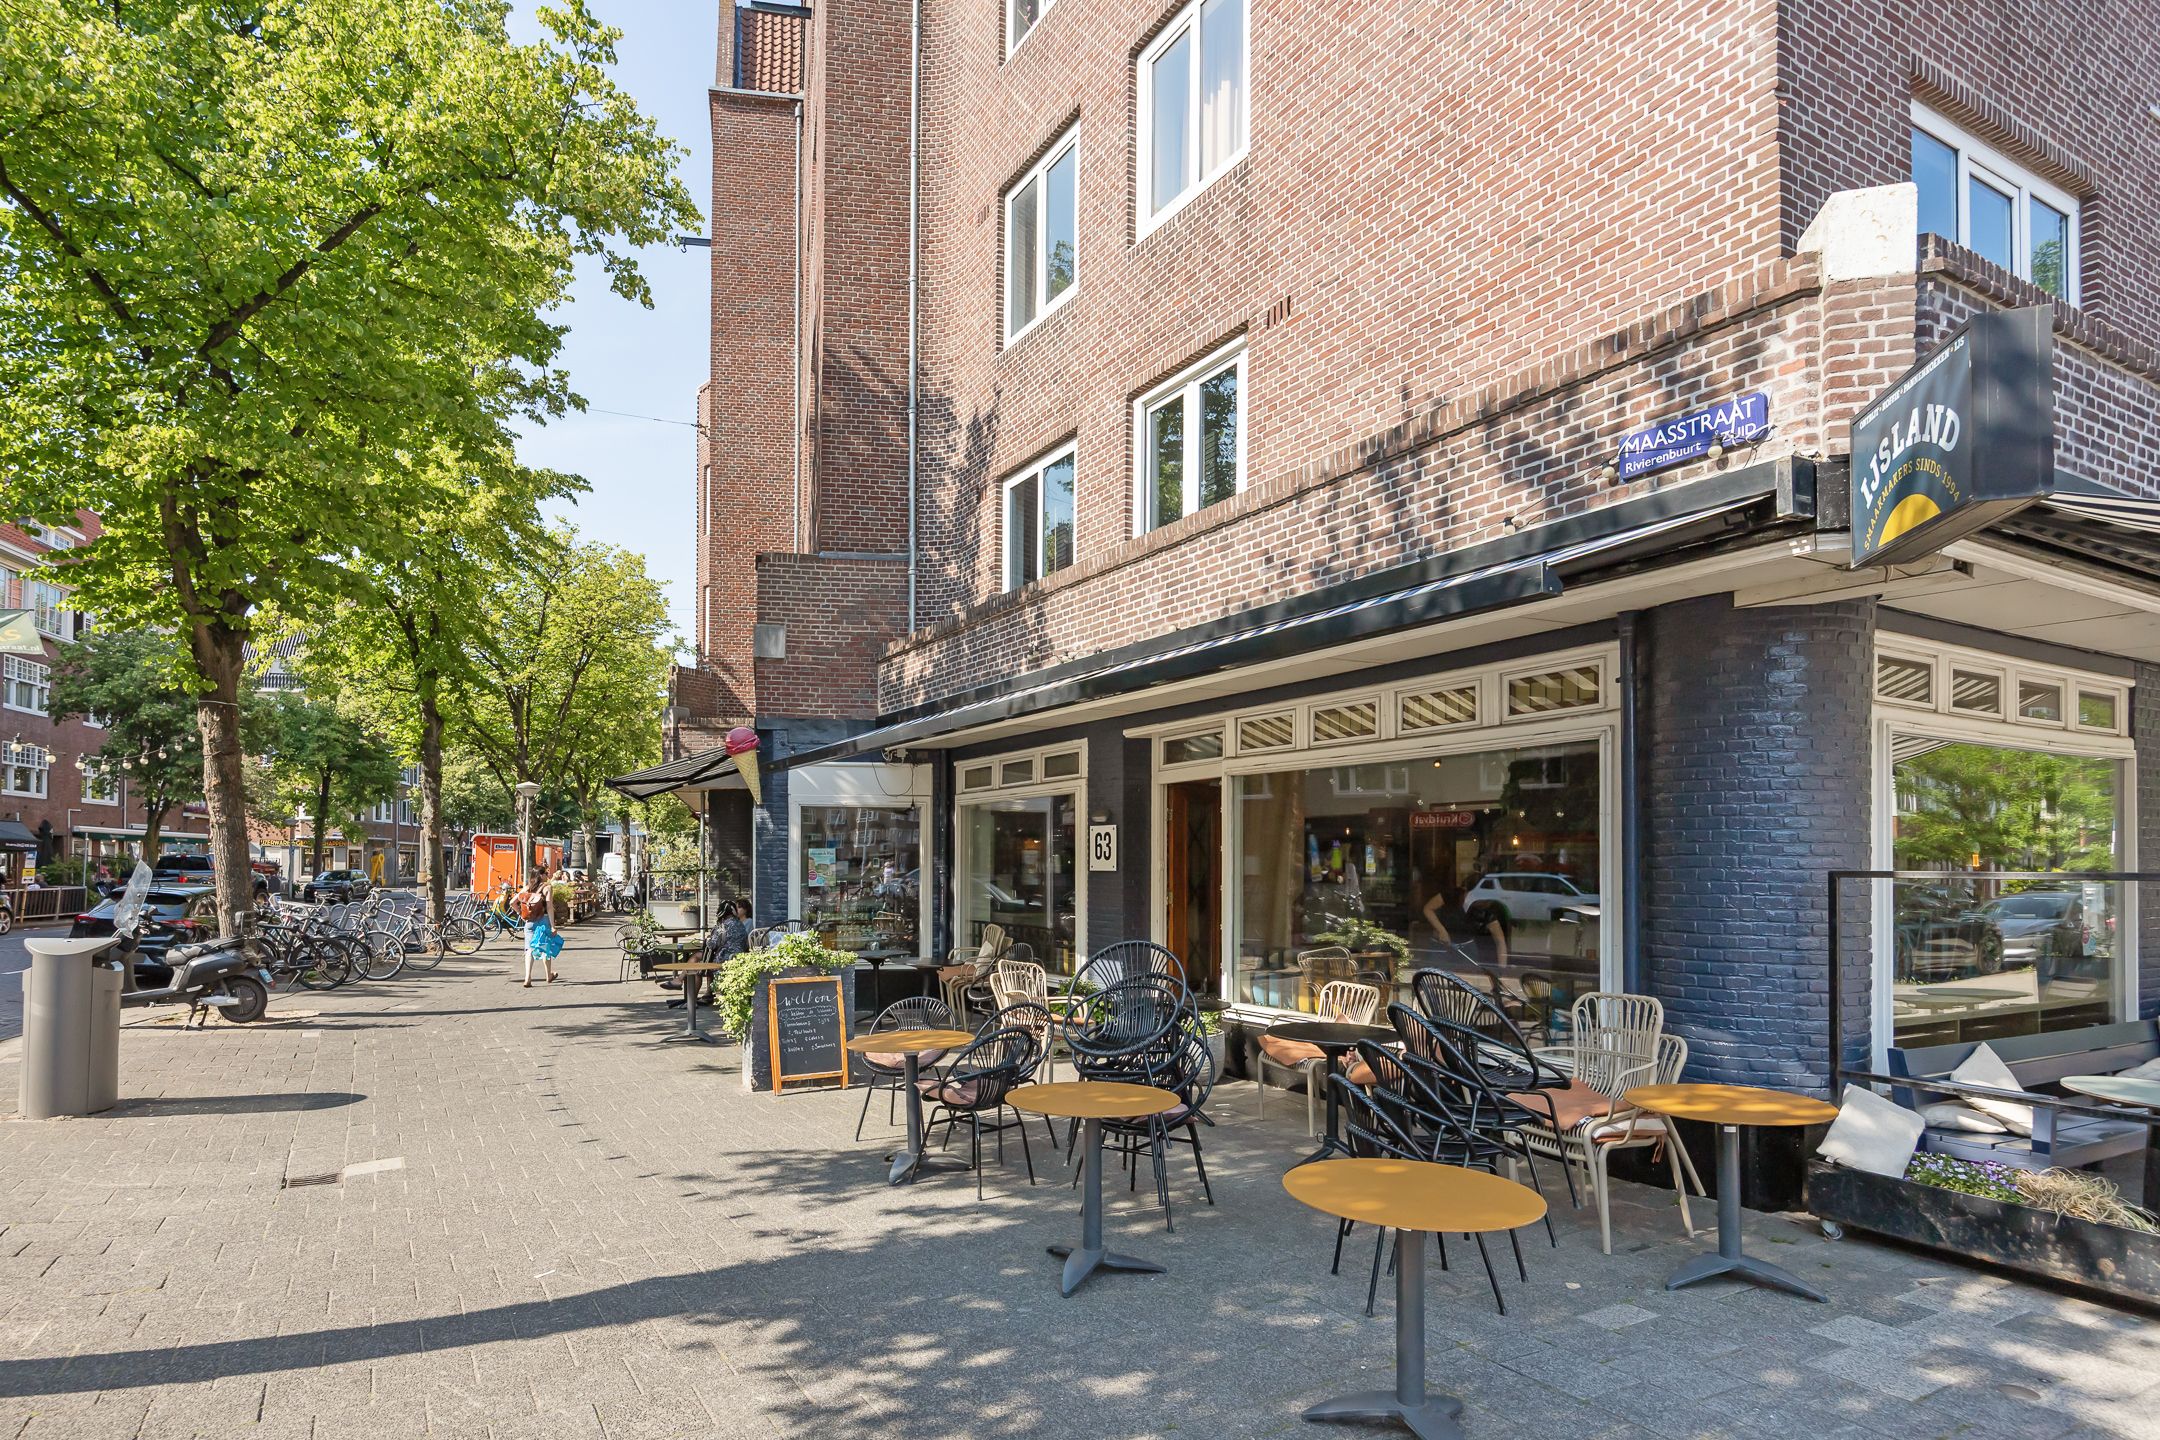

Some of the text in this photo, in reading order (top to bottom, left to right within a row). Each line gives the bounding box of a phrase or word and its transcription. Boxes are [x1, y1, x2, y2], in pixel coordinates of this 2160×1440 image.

[1624, 397, 1756, 459] MAASSTRAAT
[1625, 441, 1702, 474] Rivierenbuurt
[1860, 404, 1960, 510] IJSLAND
[1864, 457, 1960, 550] SMAAKMAKERS SINDS 1994
[1095, 832, 1111, 860] 63
